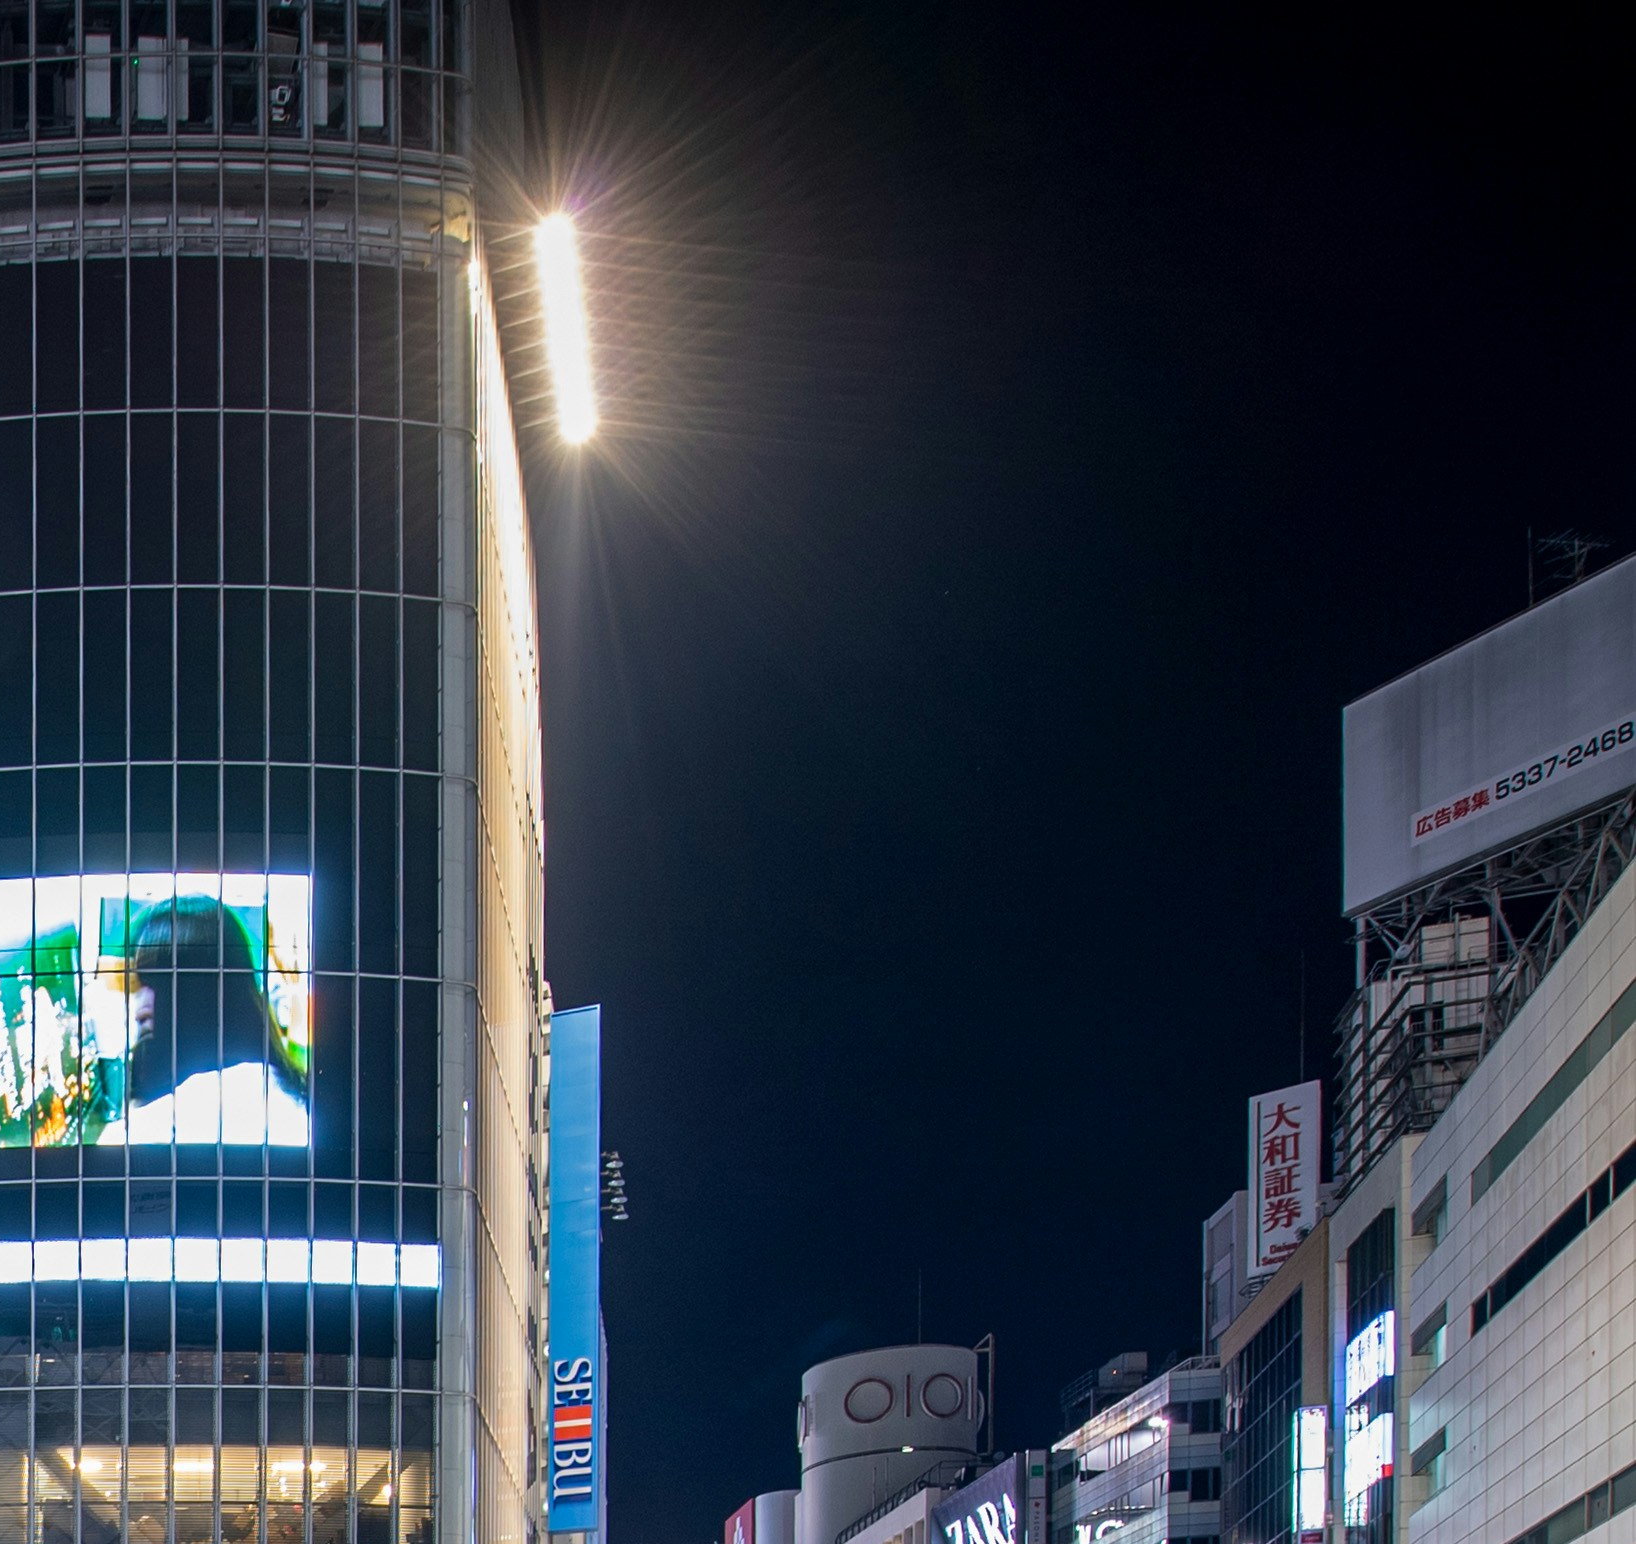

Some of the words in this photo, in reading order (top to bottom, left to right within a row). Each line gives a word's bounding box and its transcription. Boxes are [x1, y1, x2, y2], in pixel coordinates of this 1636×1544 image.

[1414, 787, 1491, 839] 広告募集
[1495, 720, 1635, 801] 5337-2468
[1261, 1101, 1302, 1233] 大和証券
[552, 1356, 593, 1501] SEIBU
